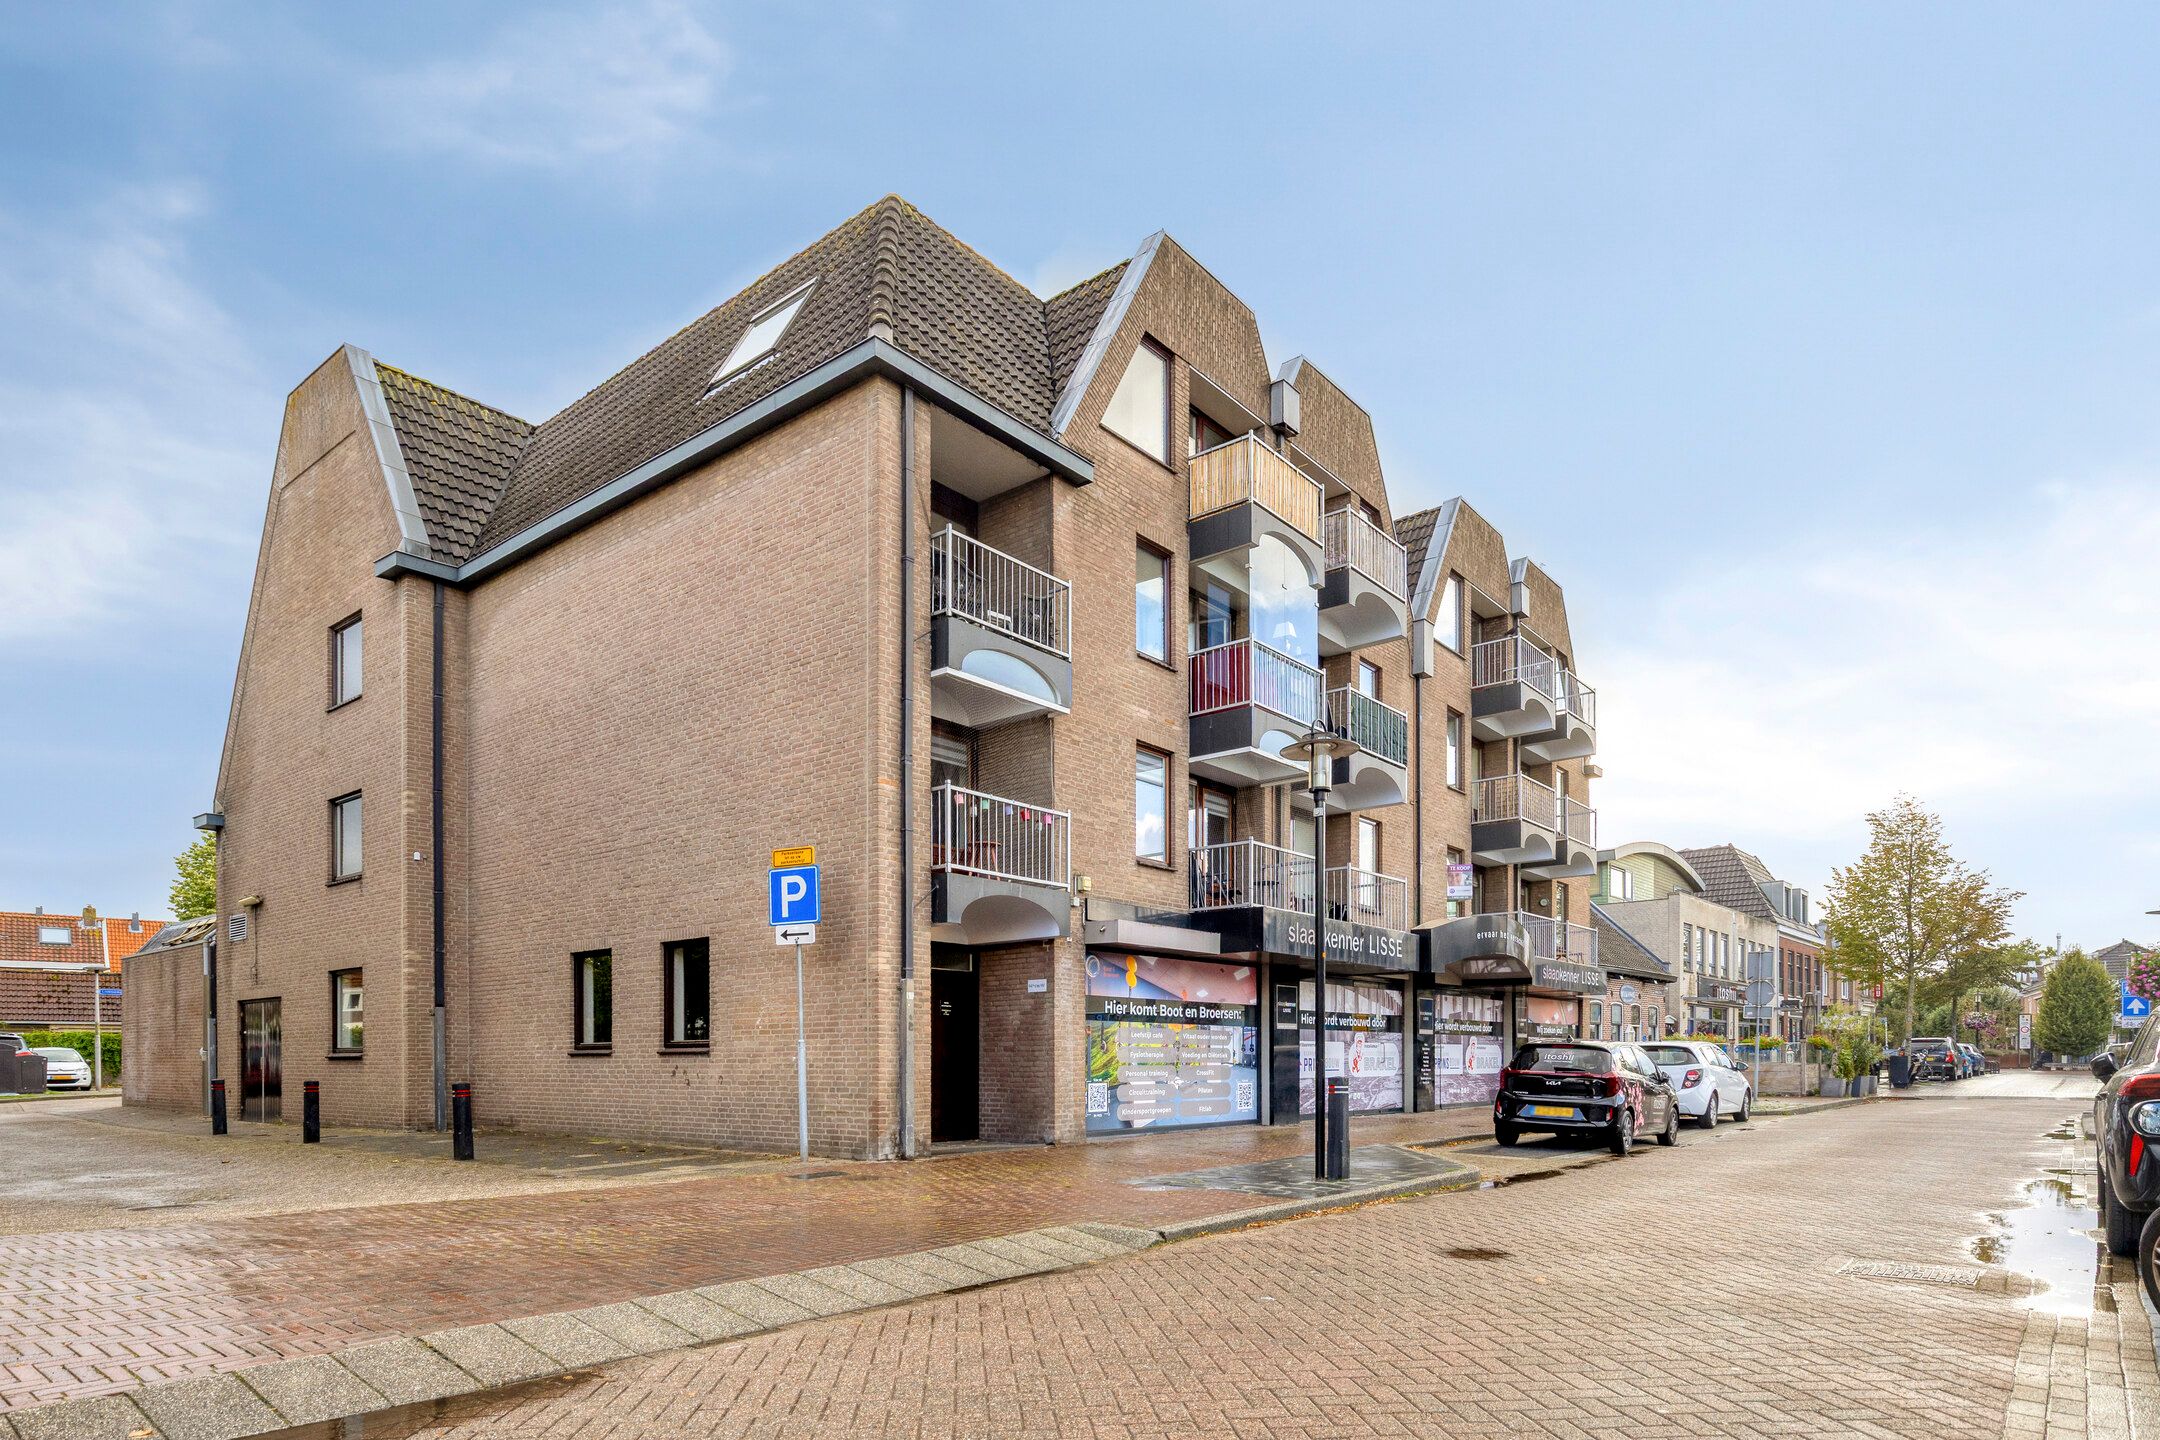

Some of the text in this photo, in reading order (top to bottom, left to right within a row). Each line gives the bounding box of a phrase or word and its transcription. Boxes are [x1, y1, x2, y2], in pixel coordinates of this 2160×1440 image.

[781, 875, 807, 918] P
[1288, 922, 1403, 958] slaakenner LISSE
[1476, 931, 1498, 940] ervaar
[1542, 965, 1600, 986] slaapkenner LISSE
[1104, 1000, 1242, 1020] Hier komt Boot en Broersen:
[1301, 1013, 1386, 1028] Hier ordt verbouwd door
[1482, 1024, 1493, 1032] door
[1130, 1052, 1164, 1060] Fysiotherapie
[1149, 1070, 1168, 1078] training
[1128, 1088, 1166, 1096] Circuittraining
[1121, 1108, 1172, 1116] Kindersportgroepen
